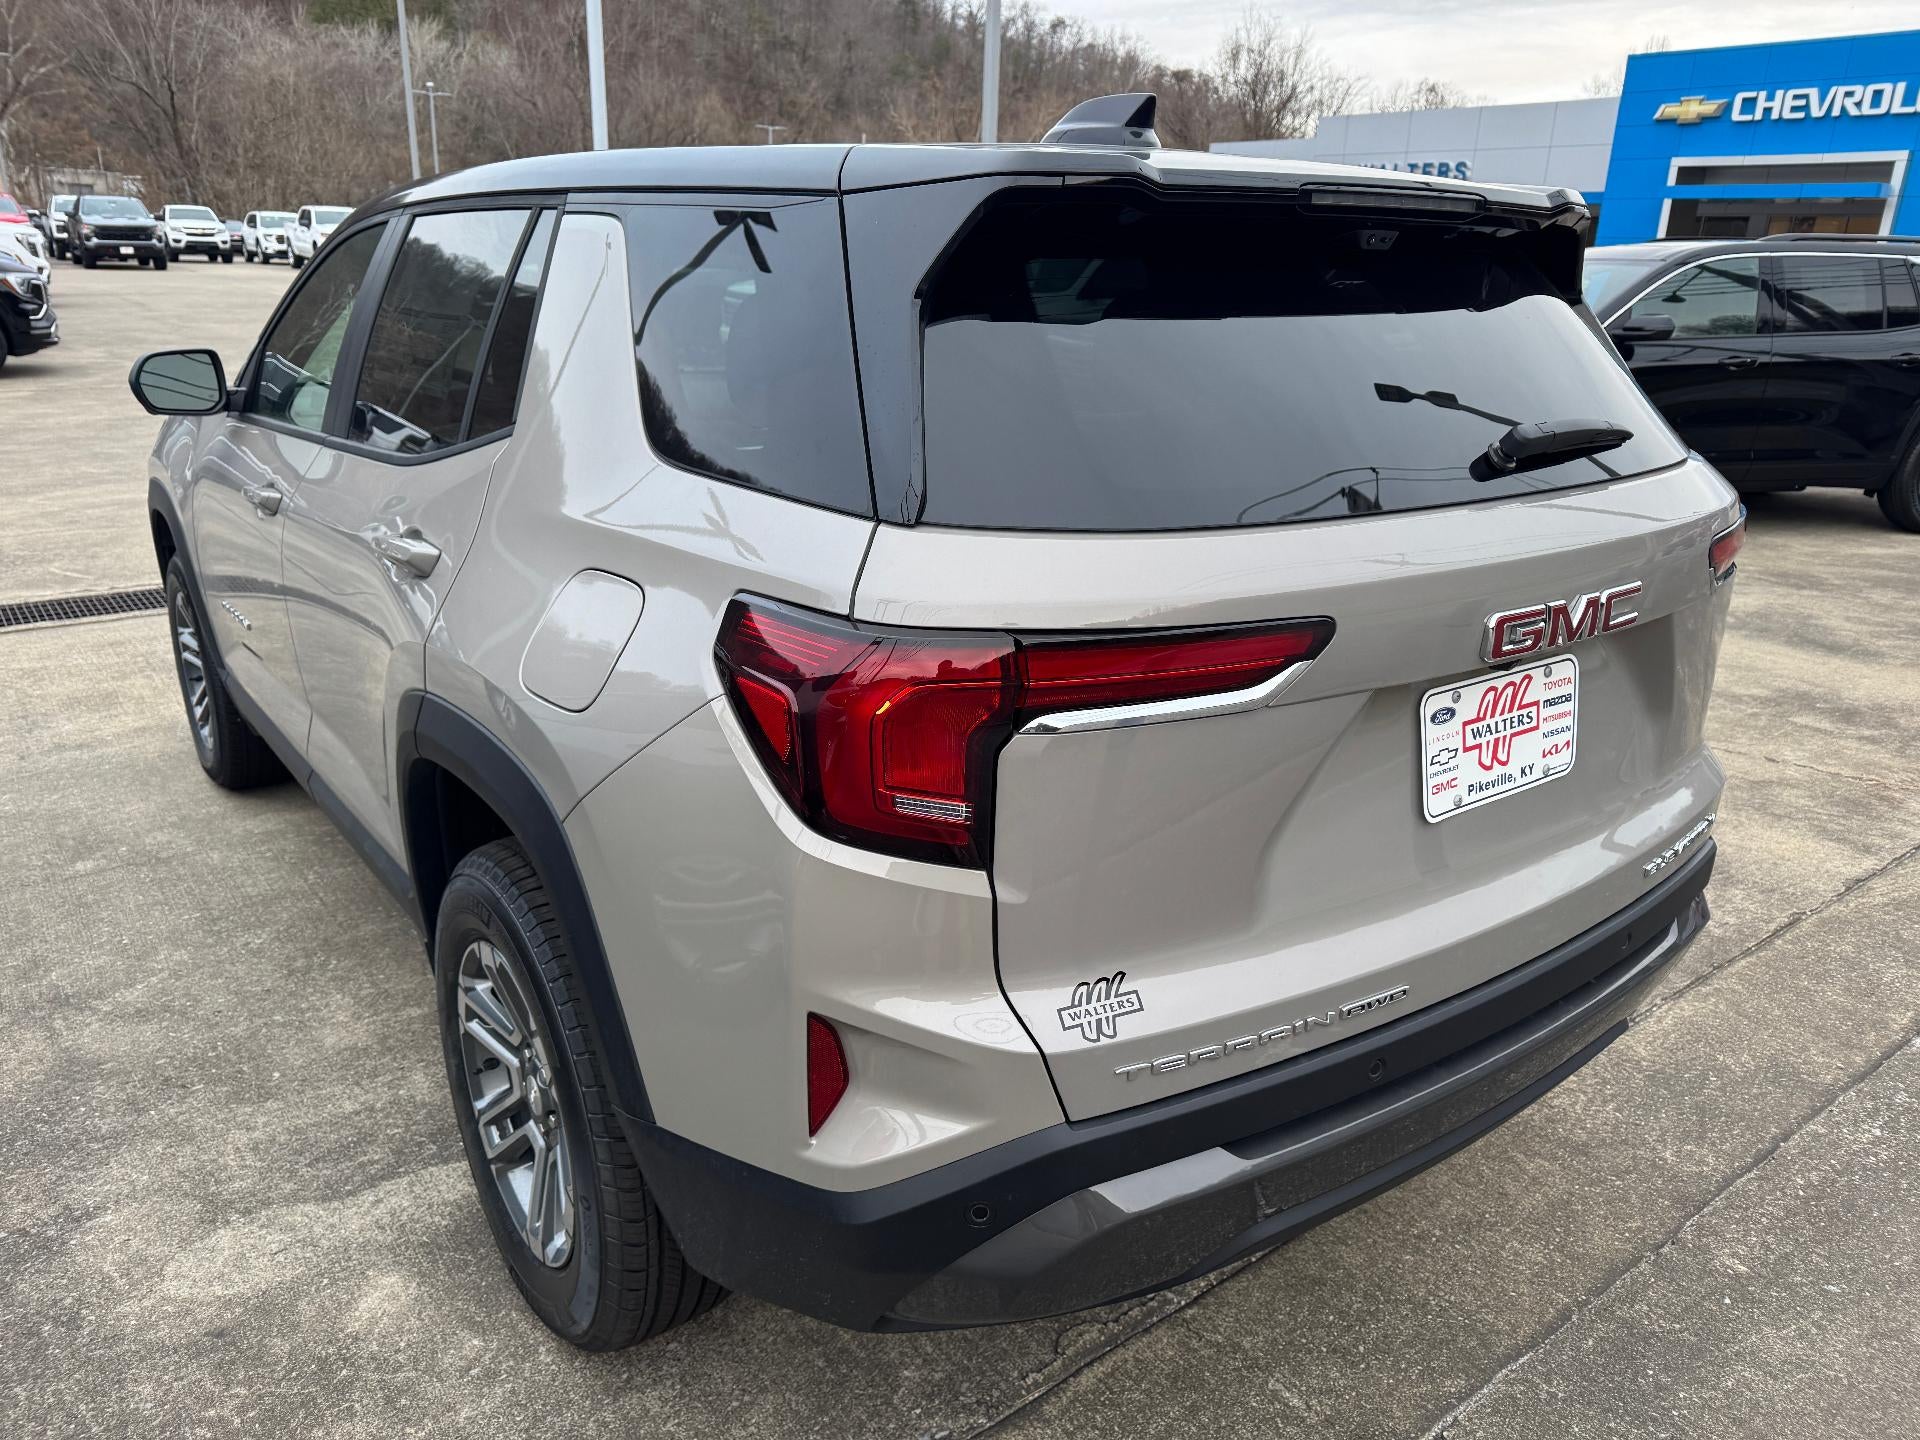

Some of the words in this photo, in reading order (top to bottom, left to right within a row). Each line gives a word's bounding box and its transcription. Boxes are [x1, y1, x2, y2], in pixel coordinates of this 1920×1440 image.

[1731, 81, 1920, 122] CHEVROL
[1481, 581, 1643, 663] GMC
[1543, 677, 1573, 692] TOYOTA
[1470, 711, 1534, 741] WALTERS
[1542, 710, 1572, 725] MITSUBISHI
[1428, 730, 1460, 746] LINCOLN
[1542, 724, 1572, 740] NISSAN
[1429, 764, 1460, 779] CHEVROLET
[1467, 772, 1517, 797] Pikeville,
[1520, 763, 1535, 780] KY
[1431, 776, 1459, 796] GMC
[1067, 997, 1135, 1022] WALTERS
[1113, 1010, 1336, 1081] TERRAIN
